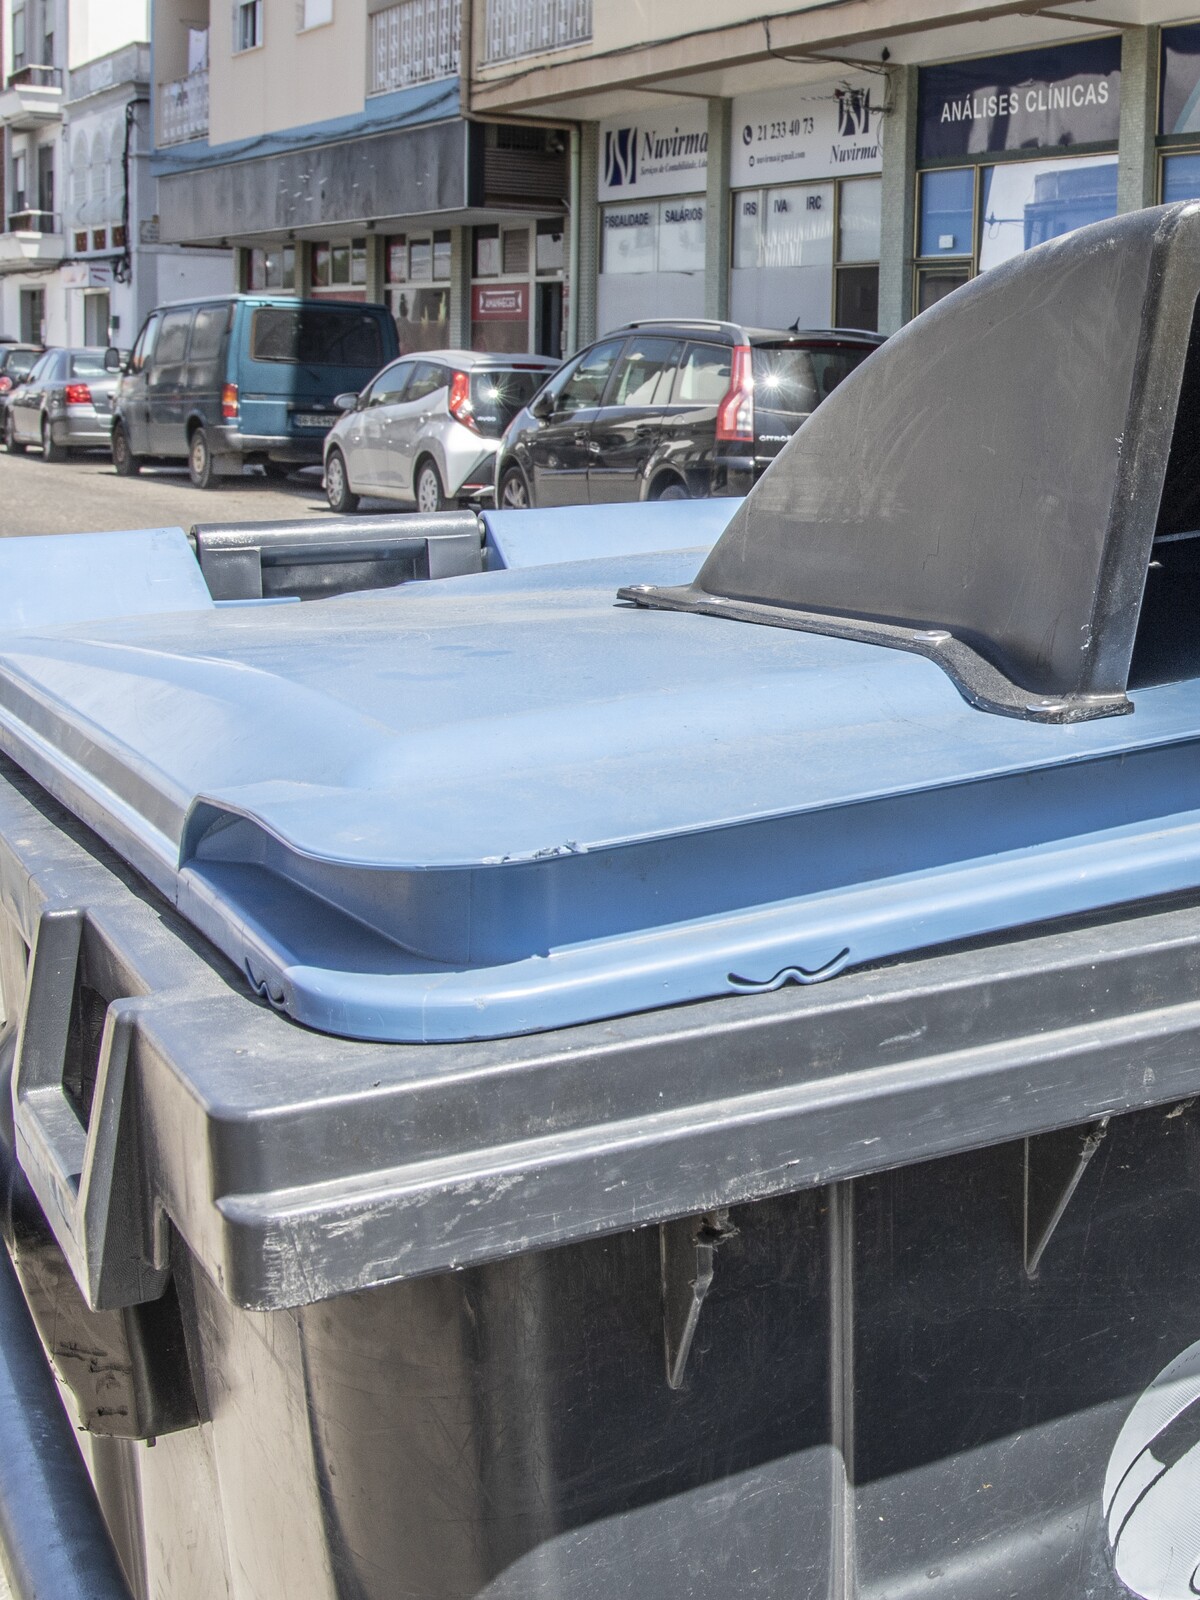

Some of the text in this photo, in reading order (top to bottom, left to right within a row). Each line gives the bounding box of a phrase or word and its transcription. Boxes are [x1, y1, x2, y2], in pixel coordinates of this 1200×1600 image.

[940, 81, 1109, 123] ANÁLISES CLÍNICAS
[757, 124, 767, 141] 21
[641, 126, 708, 160] Nuvirma
[829, 142, 878, 164] Nuvirma
[743, 201, 757, 215] IRS
[774, 199, 788, 213] IVA
[806, 195, 822, 210] IRC
[604, 212, 649, 228] FISCALIDADE
[665, 205, 703, 223] SALÁRIOS
